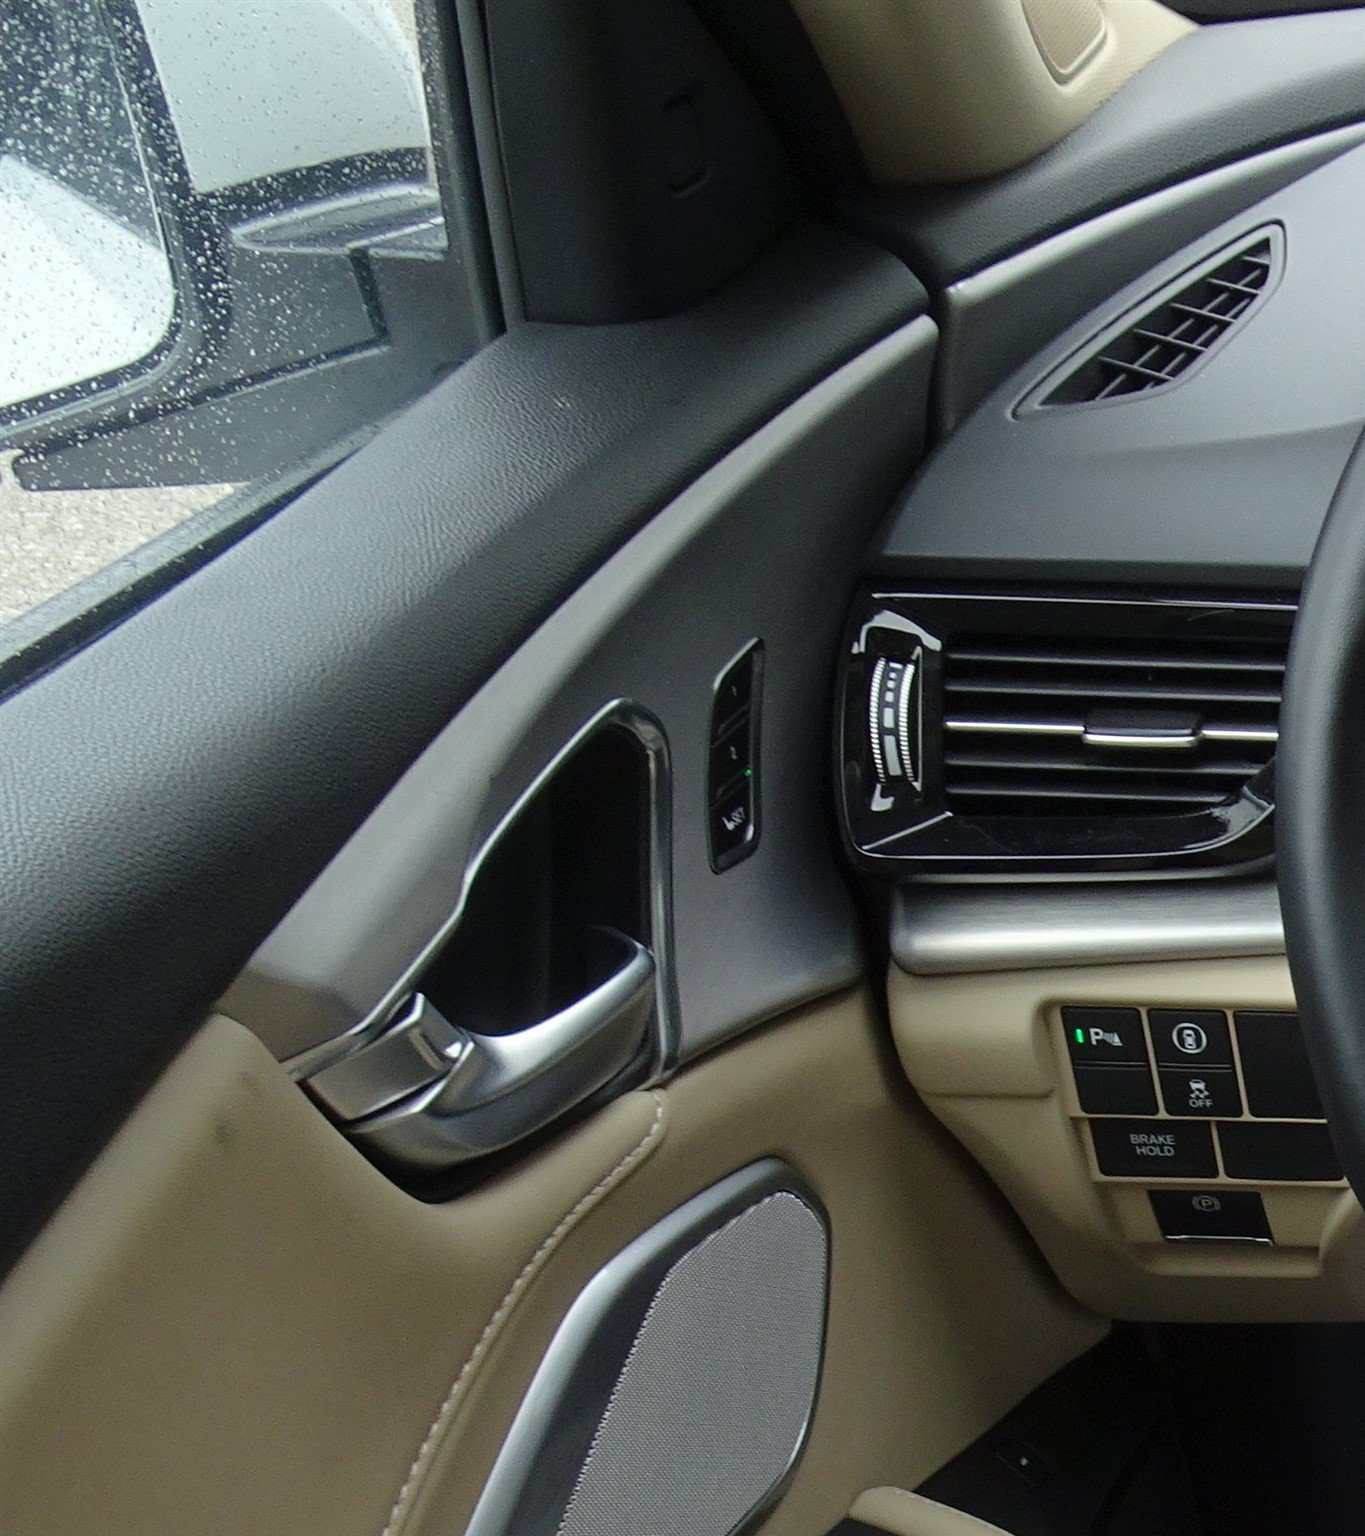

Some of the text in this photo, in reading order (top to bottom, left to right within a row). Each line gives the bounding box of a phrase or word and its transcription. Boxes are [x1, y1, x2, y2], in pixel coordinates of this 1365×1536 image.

[1188, 1099, 1213, 1108] OFF
[1130, 1134, 1176, 1146] BRAKE
[1135, 1145, 1175, 1157] HOLD
